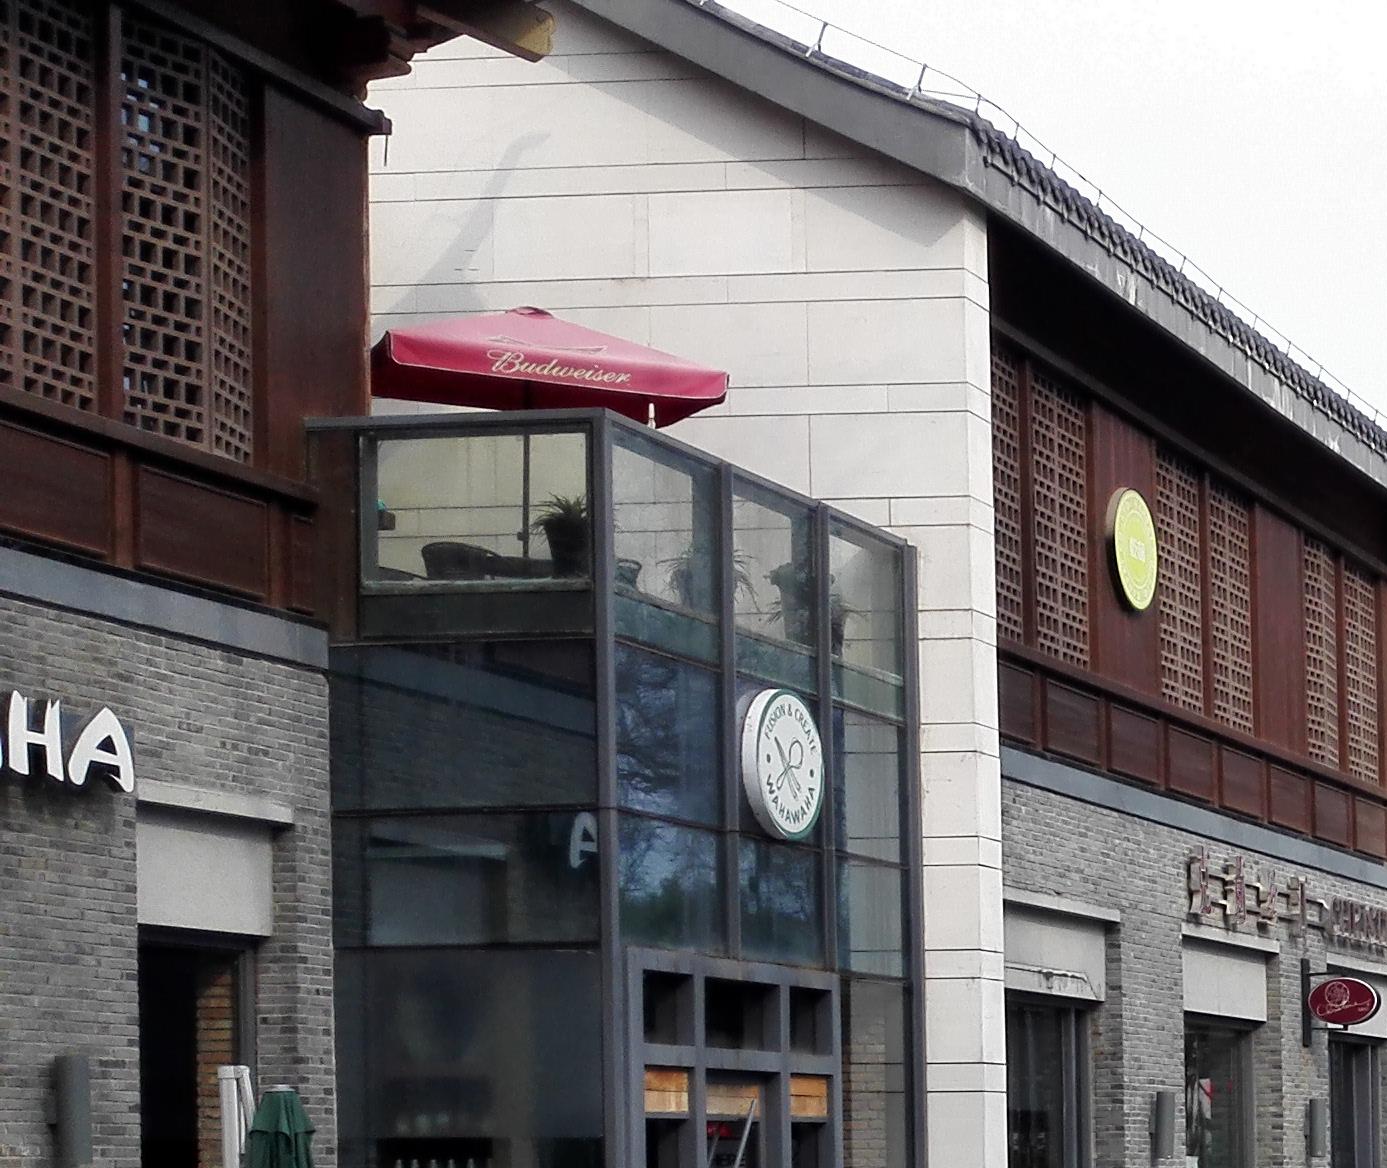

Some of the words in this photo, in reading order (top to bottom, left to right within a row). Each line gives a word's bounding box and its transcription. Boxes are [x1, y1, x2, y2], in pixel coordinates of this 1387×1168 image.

[486, 349, 632, 384] Budweiser
[0, 690, 135, 793] HA
[764, 703, 786, 741] FUSION
[786, 703, 793, 717] &
[794, 708, 818, 755] CREATE
[766, 773, 816, 825] WAHAWAHA
